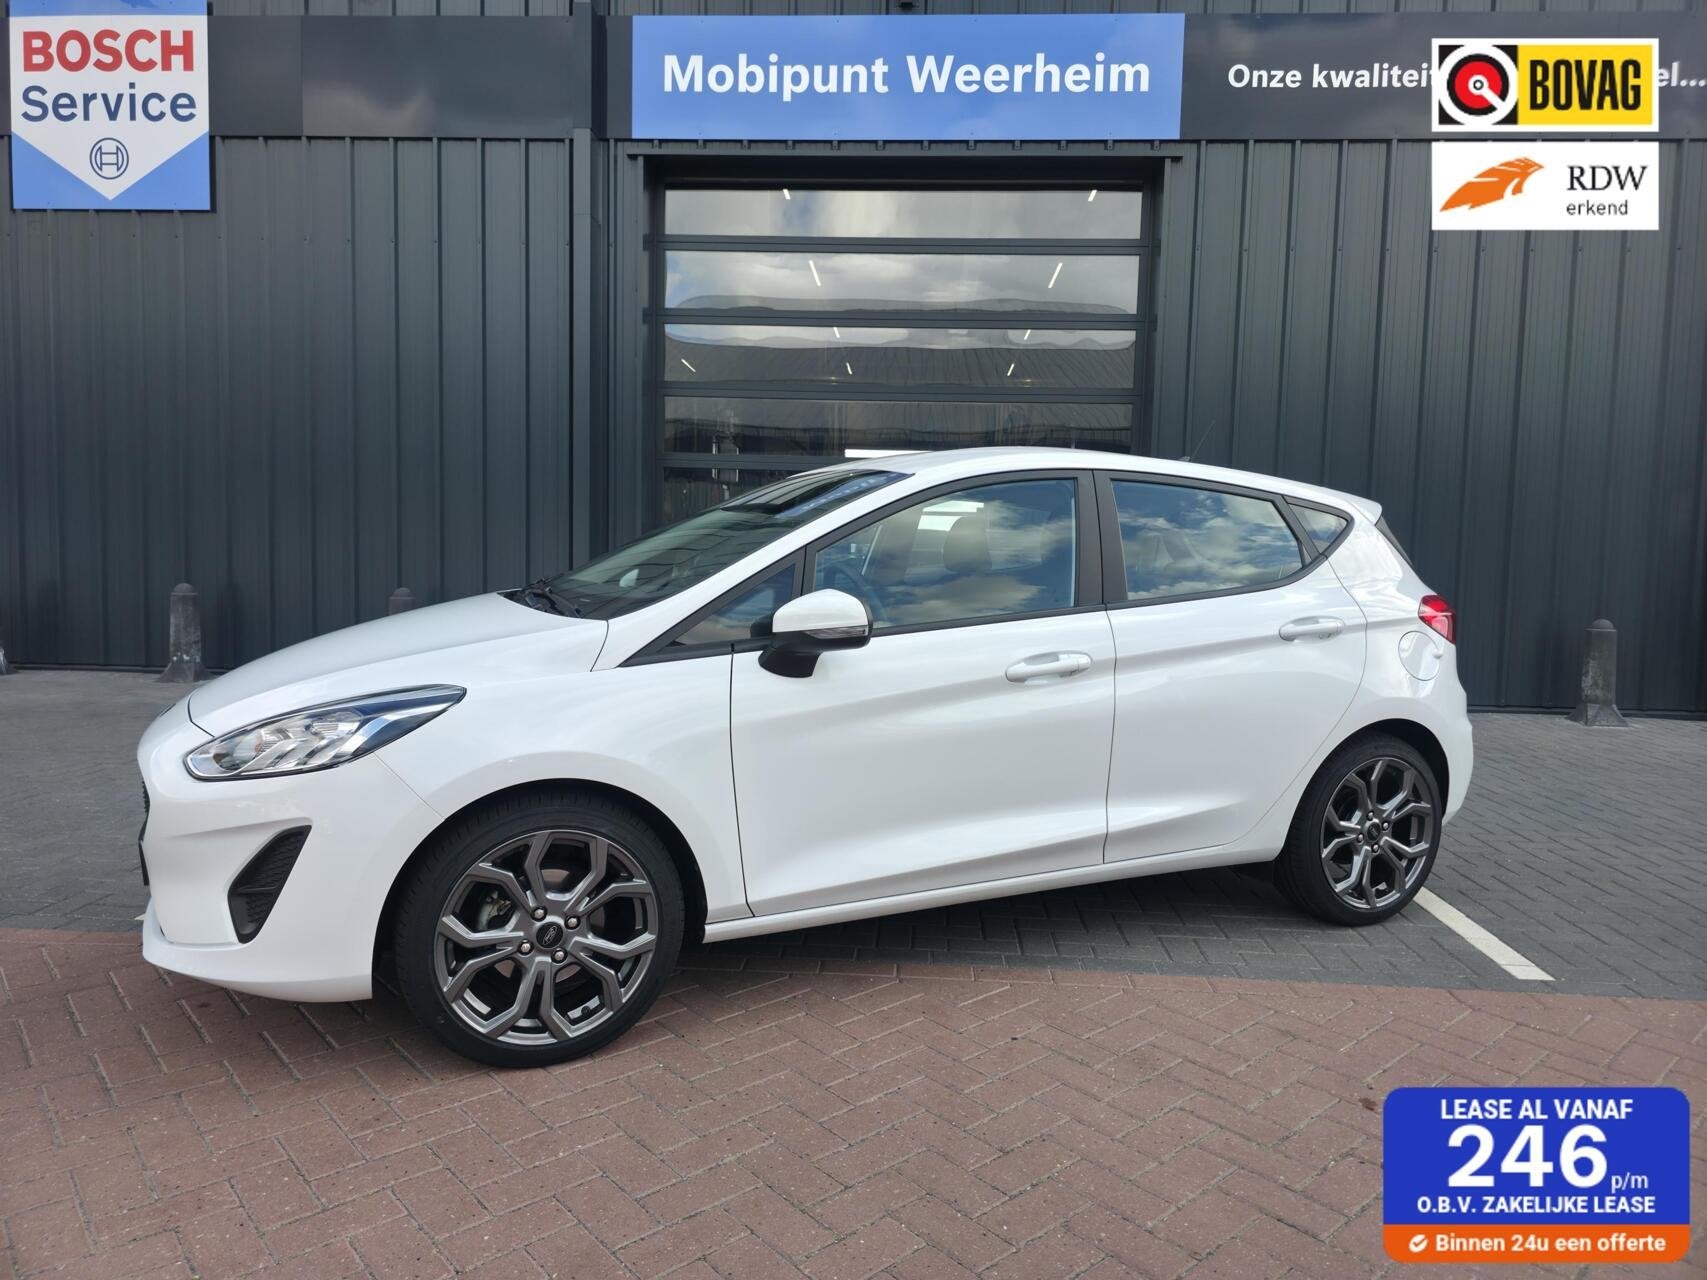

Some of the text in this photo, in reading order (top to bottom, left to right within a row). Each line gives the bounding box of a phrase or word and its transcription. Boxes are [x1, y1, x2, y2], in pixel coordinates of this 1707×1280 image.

[22, 29, 195, 72] BOSCH
[663, 52, 1150, 102] Mobipunt Weerheim
[1228, 64, 1302, 88] Onze
[1312, 62, 1432, 88] kwalitei
[21, 82, 197, 122] Service
